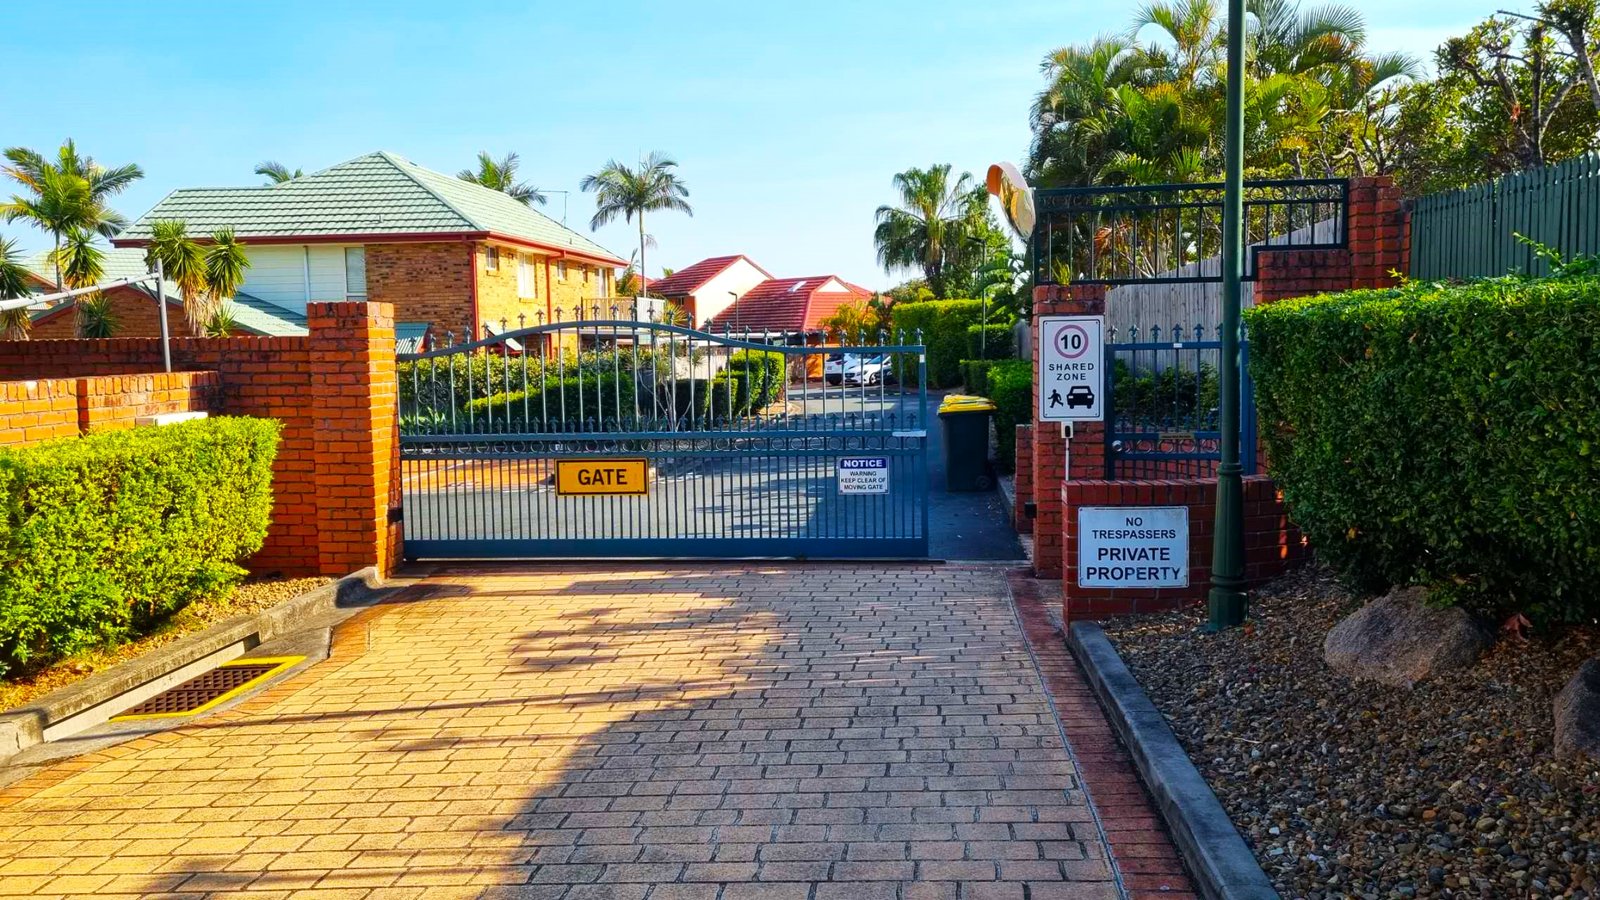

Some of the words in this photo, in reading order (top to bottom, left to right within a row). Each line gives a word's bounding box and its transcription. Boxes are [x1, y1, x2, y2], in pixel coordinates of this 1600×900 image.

[1060, 334, 1082, 350] 10
[1048, 363, 1095, 371] SHARED
[1056, 373, 1087, 381] ZONE
[843, 459, 883, 468] NOTICE
[577, 469, 628, 486] GATE
[1125, 517, 1143, 527] NO
[1092, 529, 1177, 540] TRESPASSERS
[1097, 547, 1171, 561] PRIVATE
[1086, 567, 1181, 581] PROPERTY
